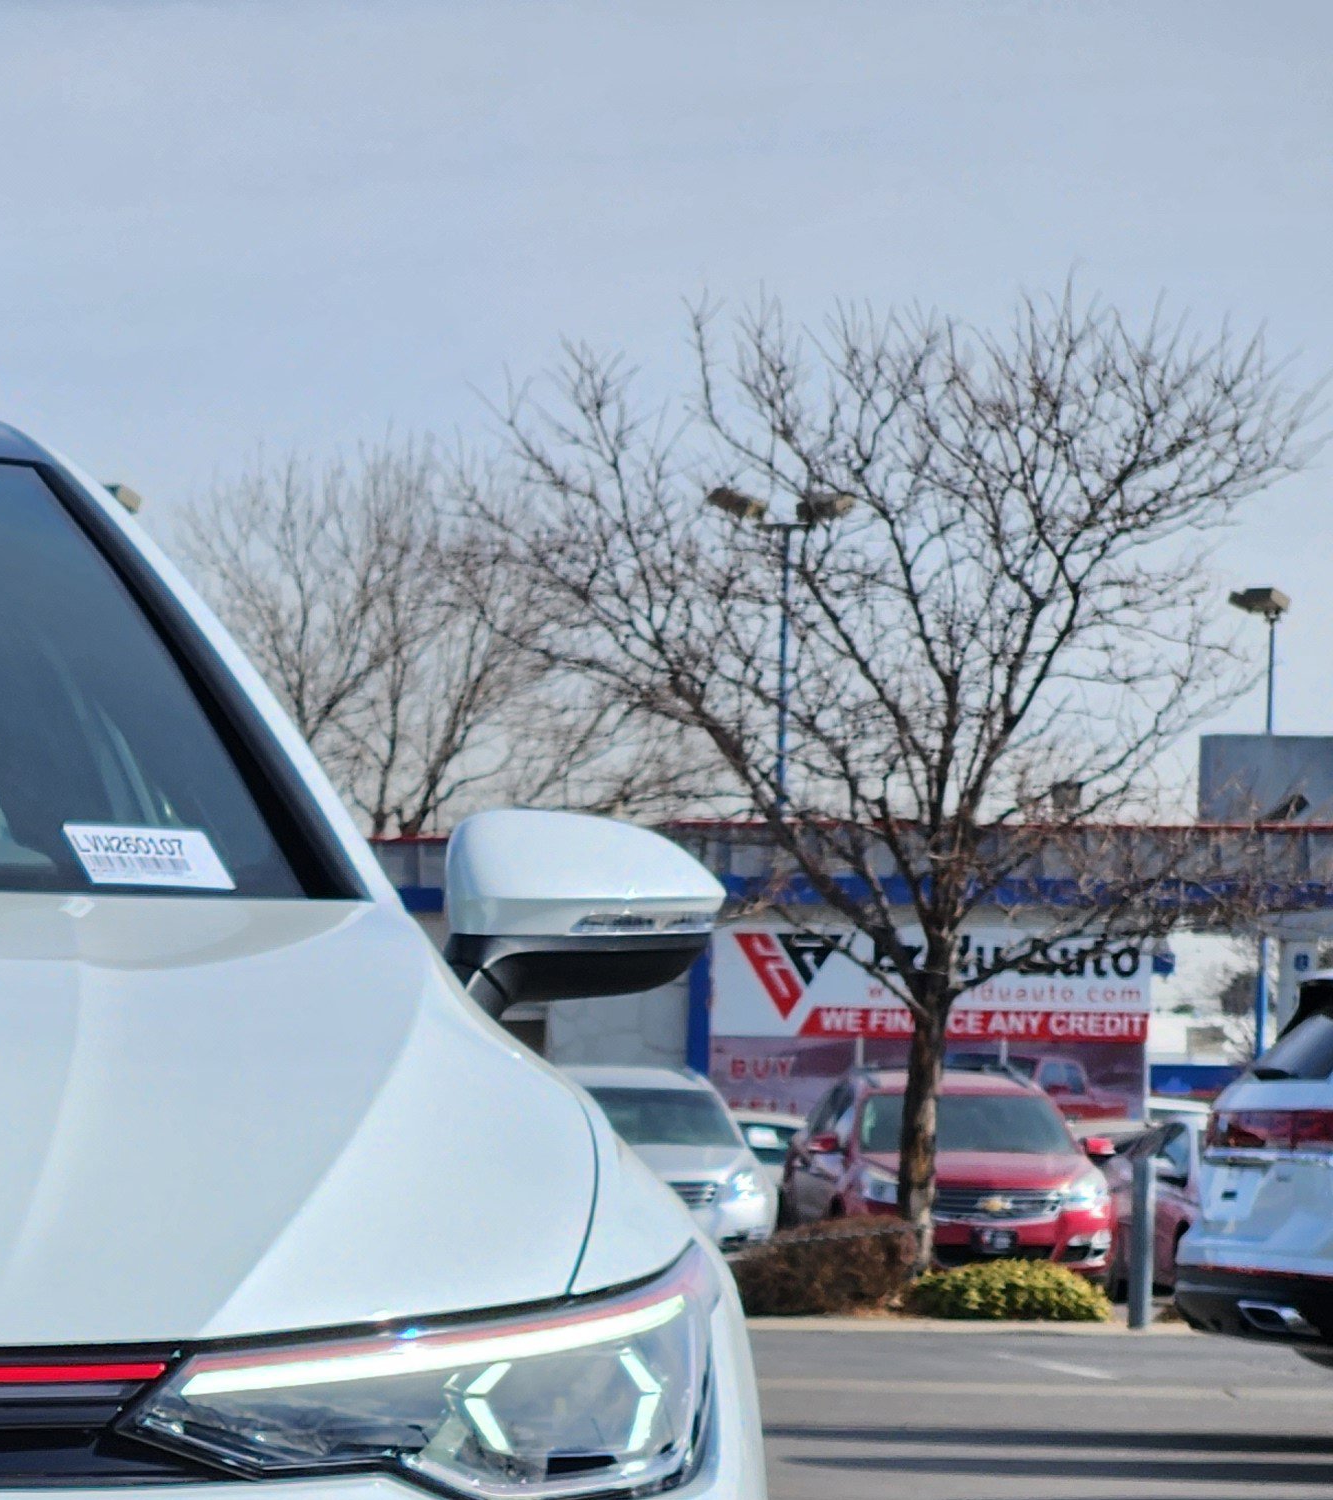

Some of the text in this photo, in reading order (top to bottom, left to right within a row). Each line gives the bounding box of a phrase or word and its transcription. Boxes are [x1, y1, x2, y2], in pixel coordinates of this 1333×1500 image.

[72, 834, 184, 856] LVW260107
[819, 1009, 1145, 1037] WE FINCE ANY CREDIT
[730, 1057, 795, 1082] BUY
